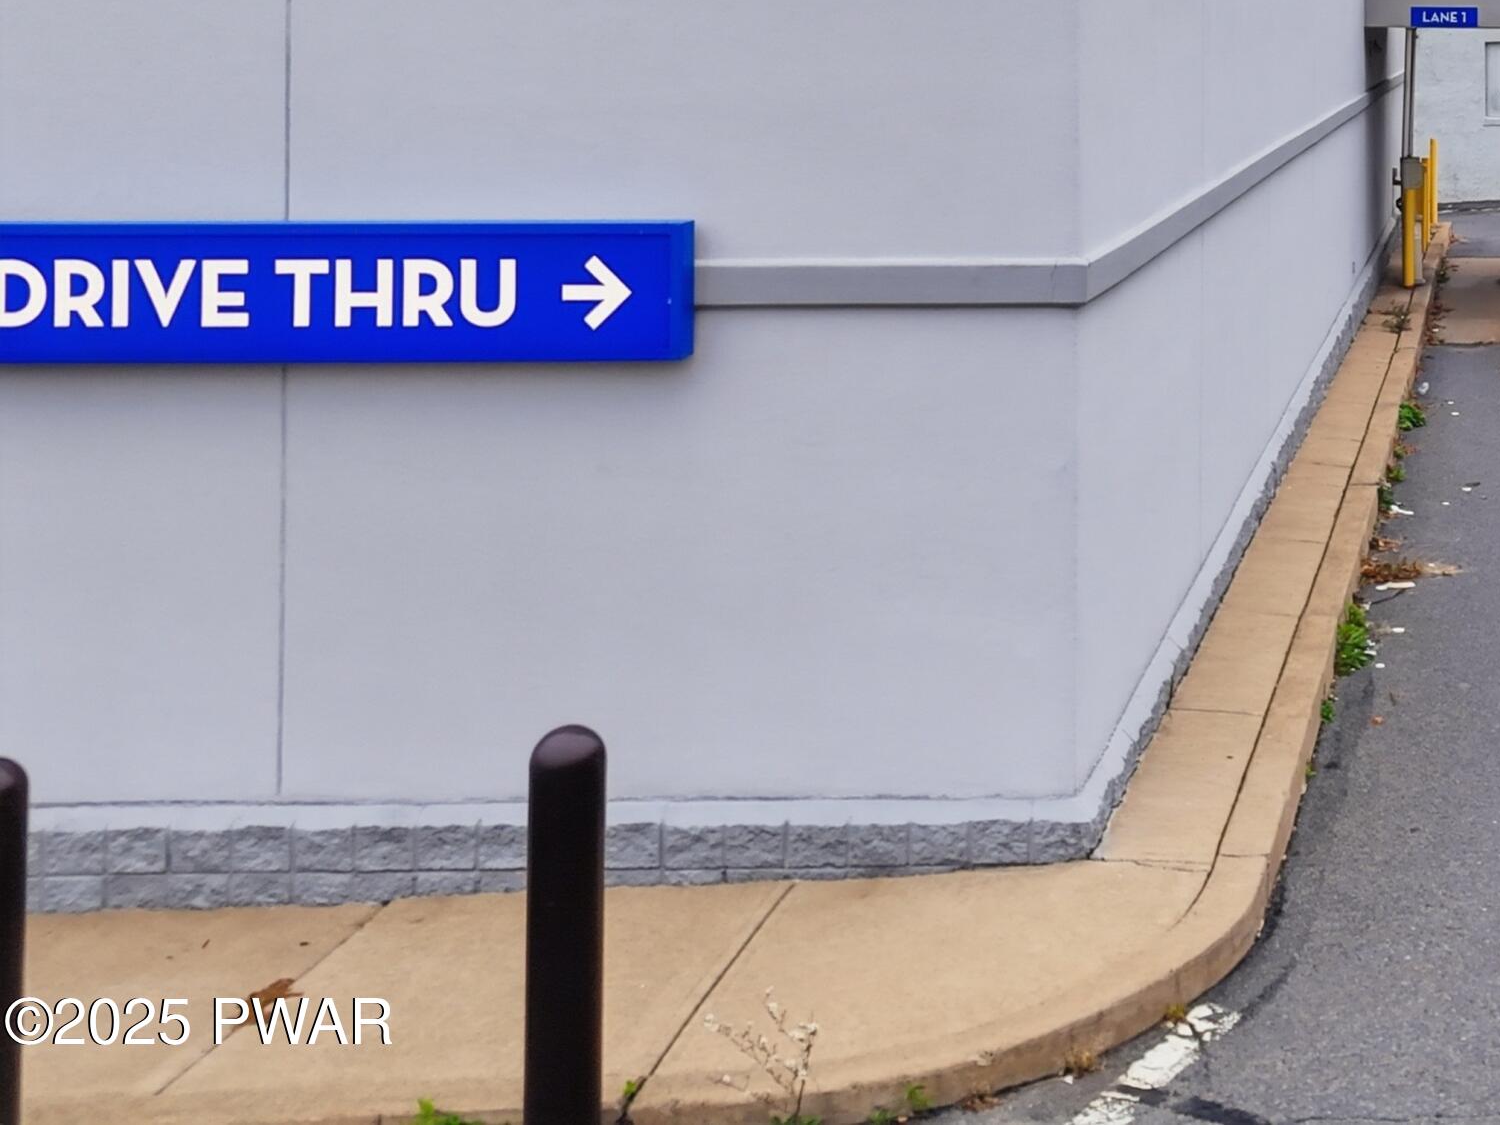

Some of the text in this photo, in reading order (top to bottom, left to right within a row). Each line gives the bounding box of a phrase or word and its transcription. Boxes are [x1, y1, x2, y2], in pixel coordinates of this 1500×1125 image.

[1422, 11, 1467, 23] LANE 1
[0, 258, 517, 328] DRIVE THRU
